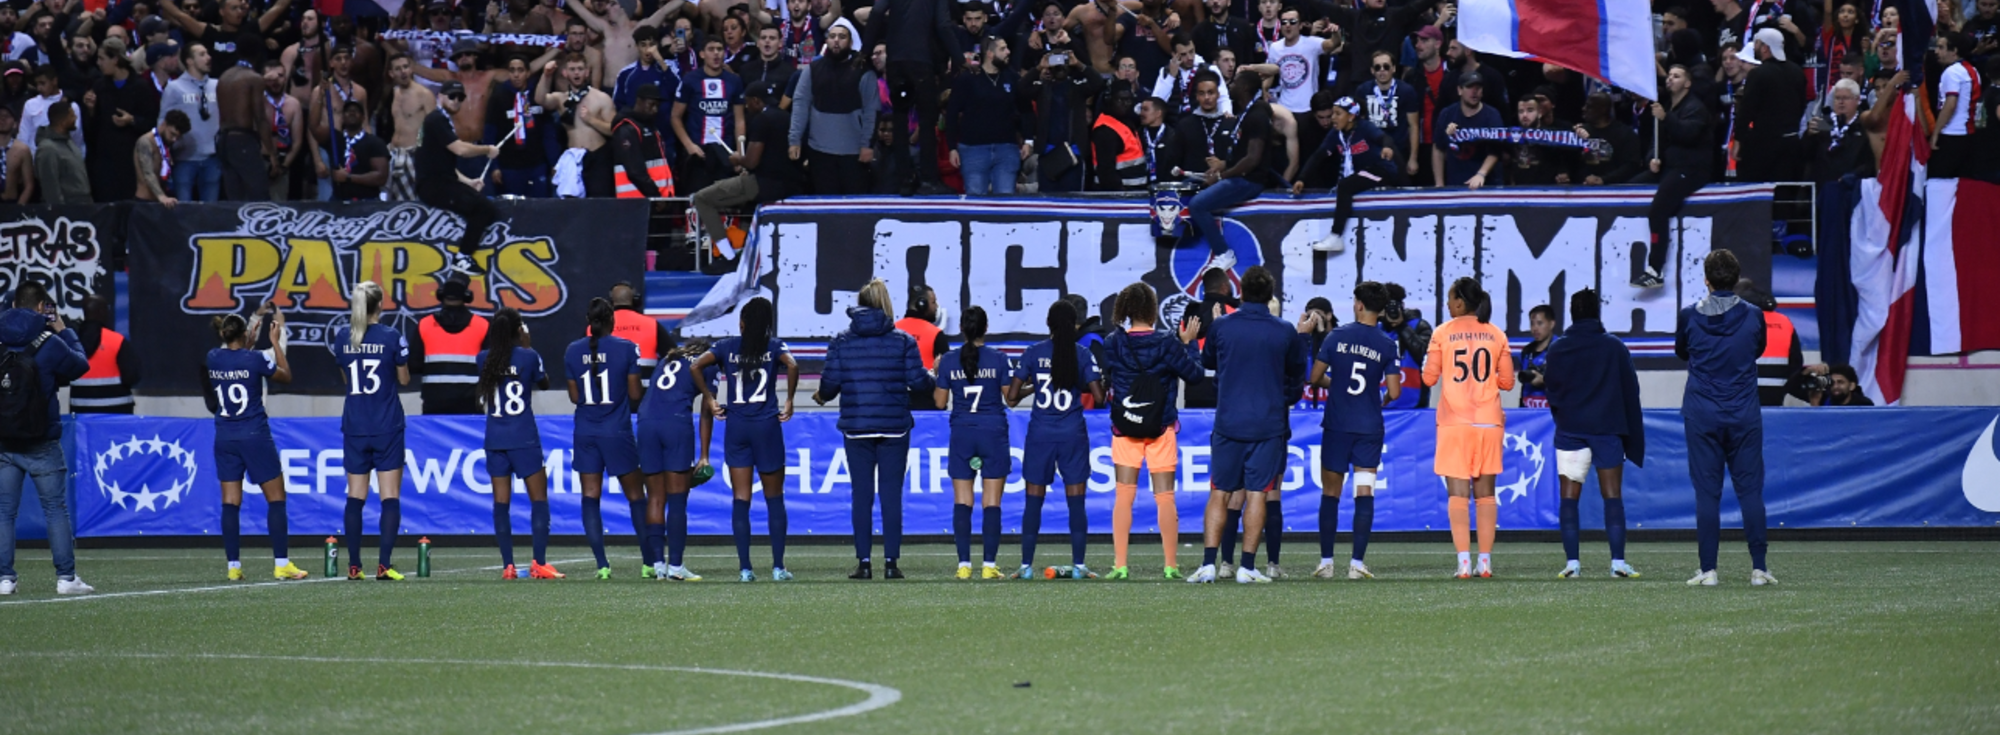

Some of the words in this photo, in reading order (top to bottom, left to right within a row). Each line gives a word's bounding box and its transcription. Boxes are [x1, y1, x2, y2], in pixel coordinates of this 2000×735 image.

[698, 101, 728, 111] QATAR
[0, 217, 99, 266] TRAS
[239, 203, 388, 247] Collectif
[382, 203, 503, 247] Ultrs
[183, 233, 563, 312] PARIS
[298, 327, 322, 341] 19
[1336, 342, 1349, 354] DE
[1349, 343, 1381, 363] ALMEIDA
[1453, 347, 1492, 382] 50
[208, 370, 250, 380] CASCARINO
[348, 359, 382, 395] 13
[580, 368, 615, 404] 11
[656, 360, 682, 390] 8
[731, 368, 768, 404] 12
[1036, 373, 1073, 411] 36
[1346, 361, 1367, 396] 5
[214, 383, 249, 417] 19
[491, 380, 525, 418] 18
[963, 385, 984, 413] 7
[1122, 410, 1144, 424] PARIS
